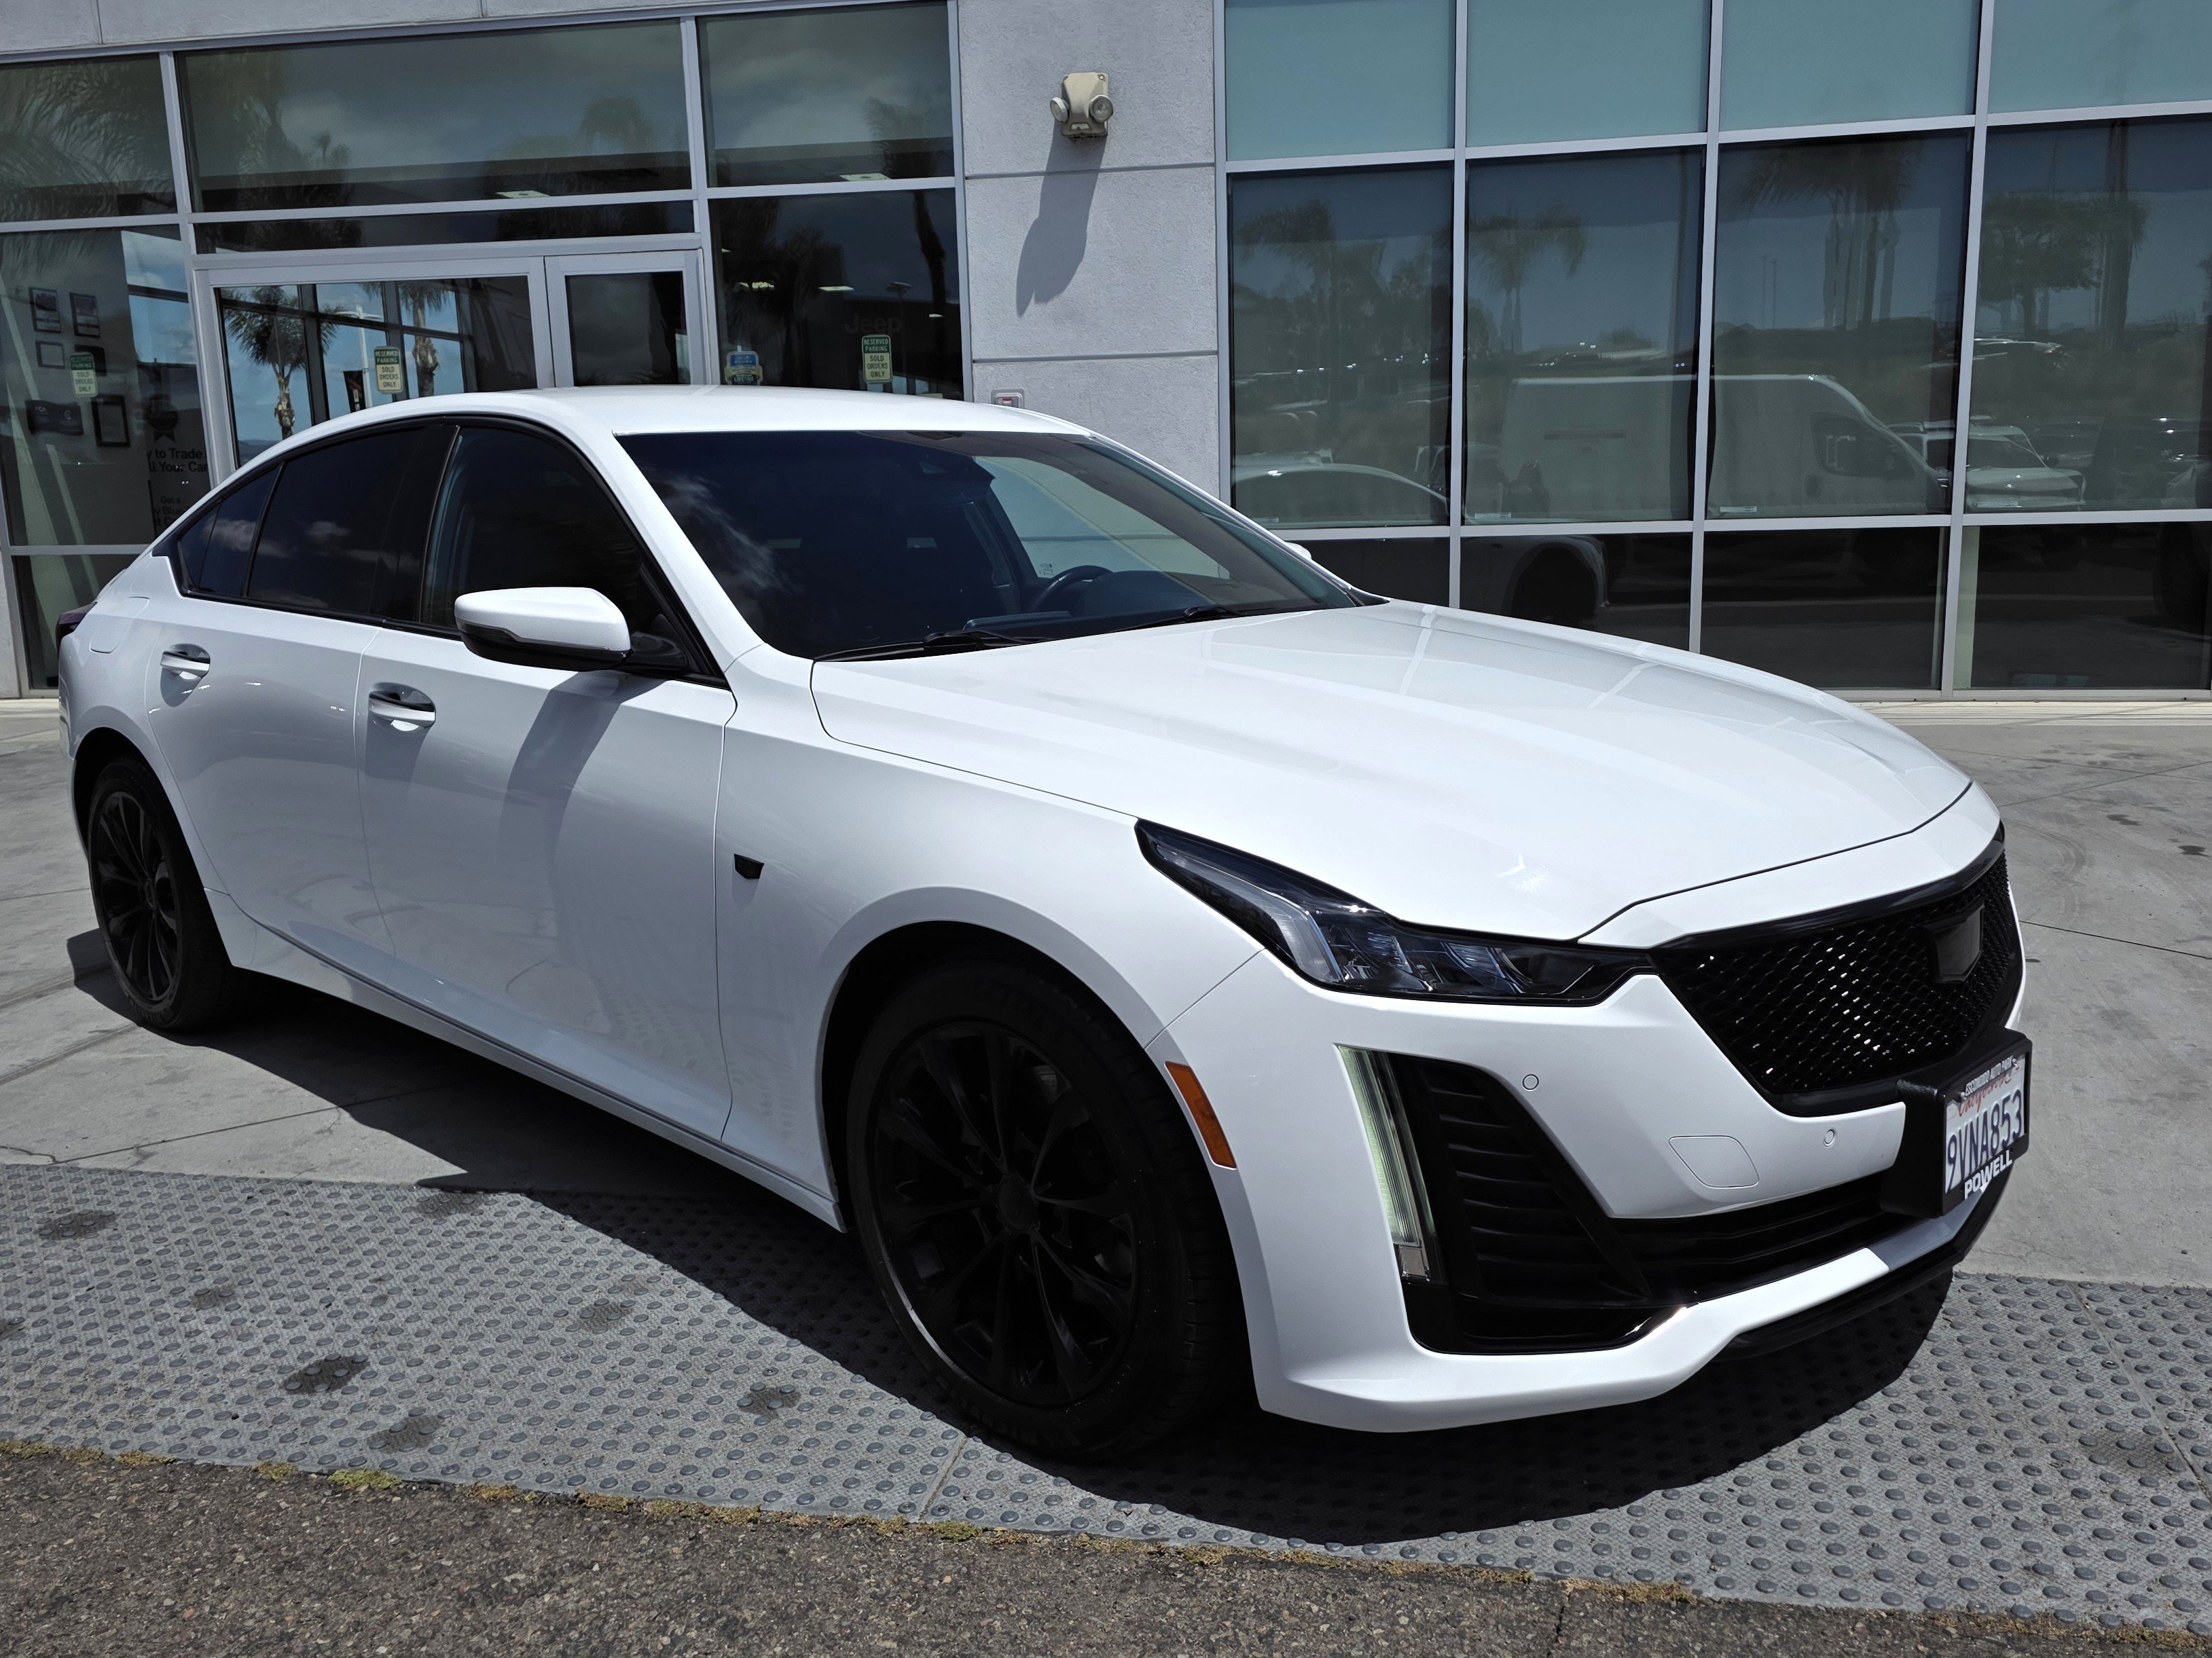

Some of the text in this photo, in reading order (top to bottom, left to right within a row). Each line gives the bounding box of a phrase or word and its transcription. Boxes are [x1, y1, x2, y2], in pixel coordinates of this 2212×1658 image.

[843, 313, 902, 337] Jeep
[155, 448, 166, 459] to
[168, 448, 203, 459] Trade
[158, 461, 185, 473] Your
[1947, 1089, 2022, 1192] 9VNA853
[1964, 1149, 2012, 1200] POWELL
